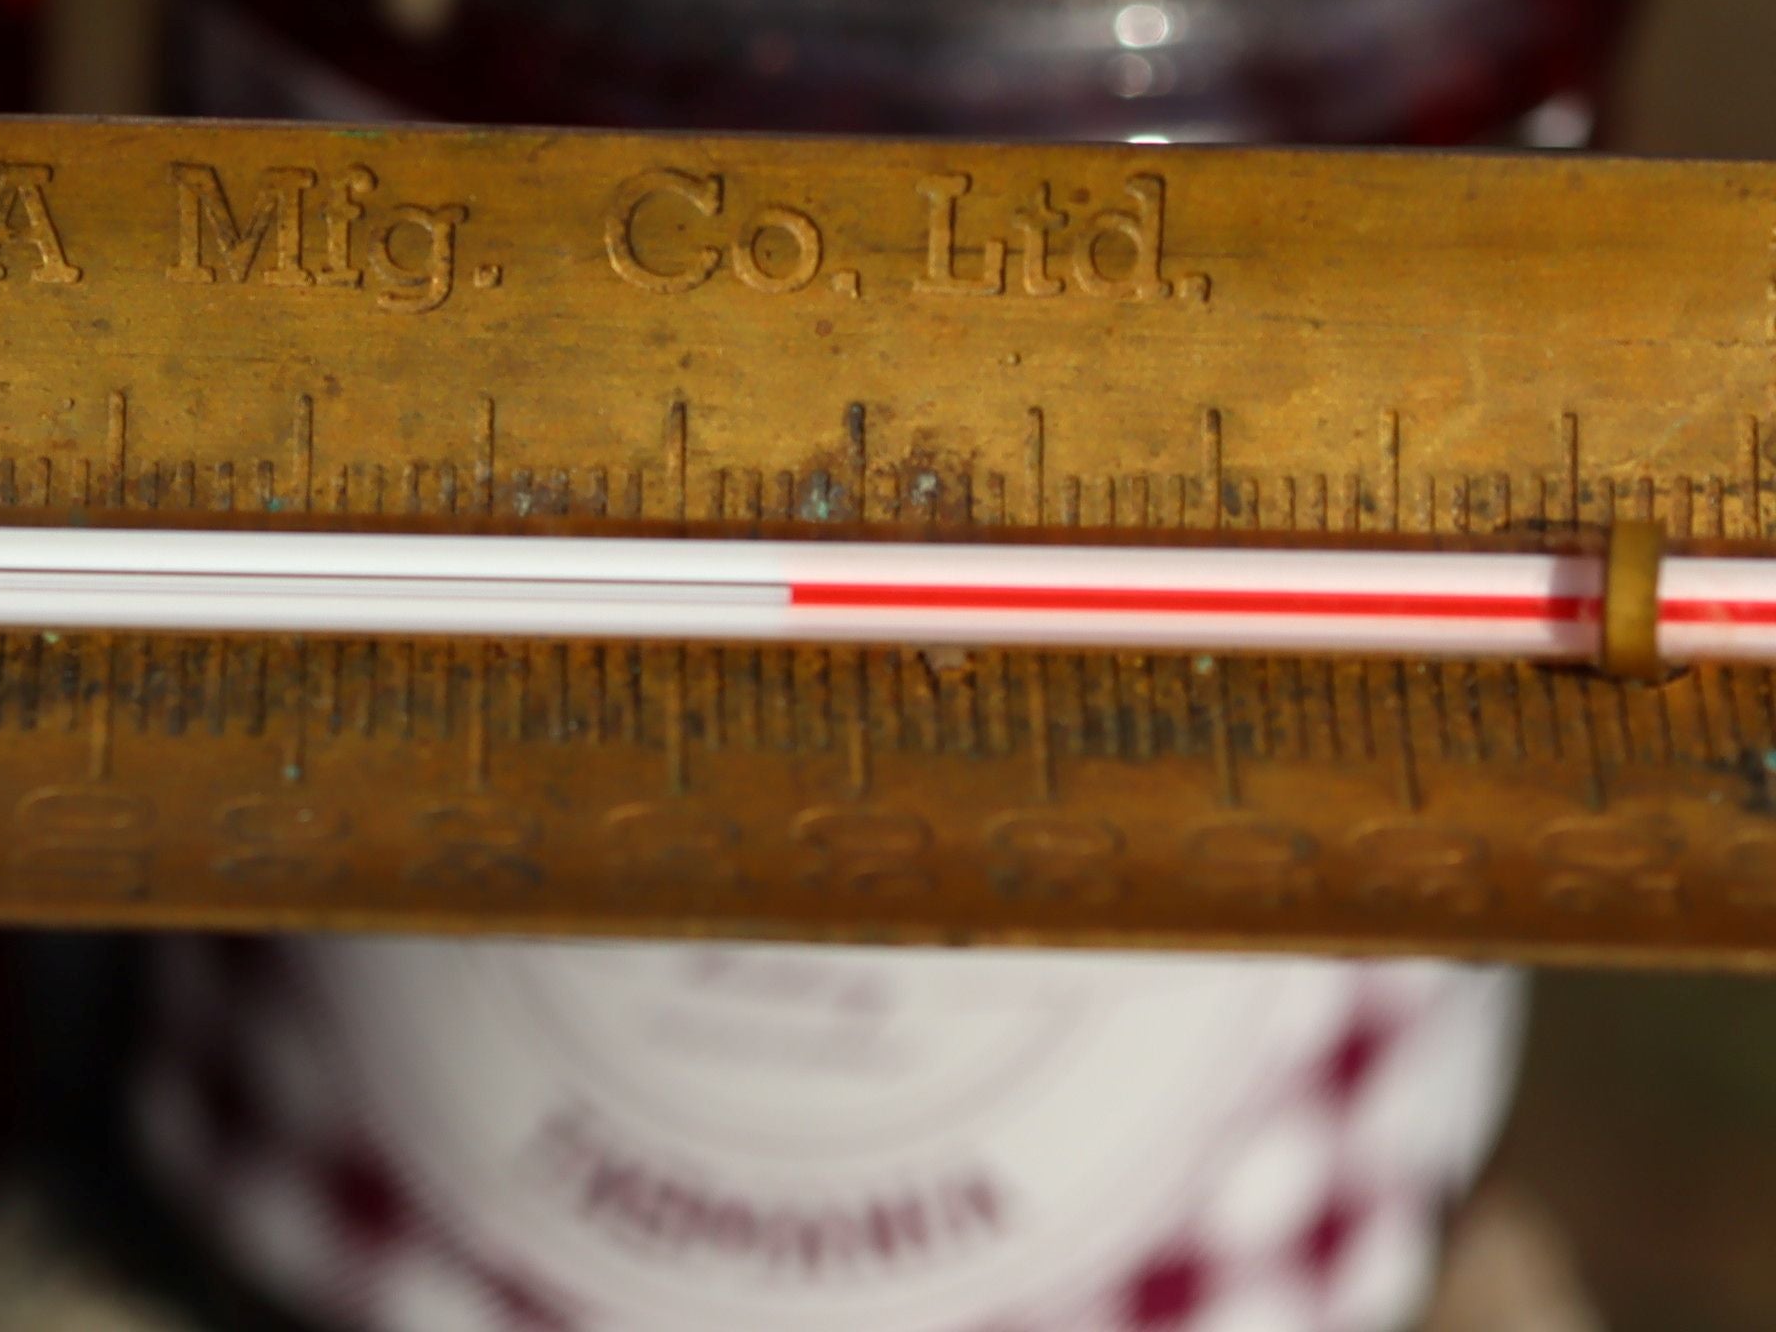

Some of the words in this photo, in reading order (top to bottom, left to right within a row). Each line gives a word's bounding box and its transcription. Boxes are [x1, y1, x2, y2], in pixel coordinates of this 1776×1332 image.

[166, 161, 504, 313] Mfg.
[605, 168, 864, 300] Co.
[912, 172, 1212, 308] Ltd.
